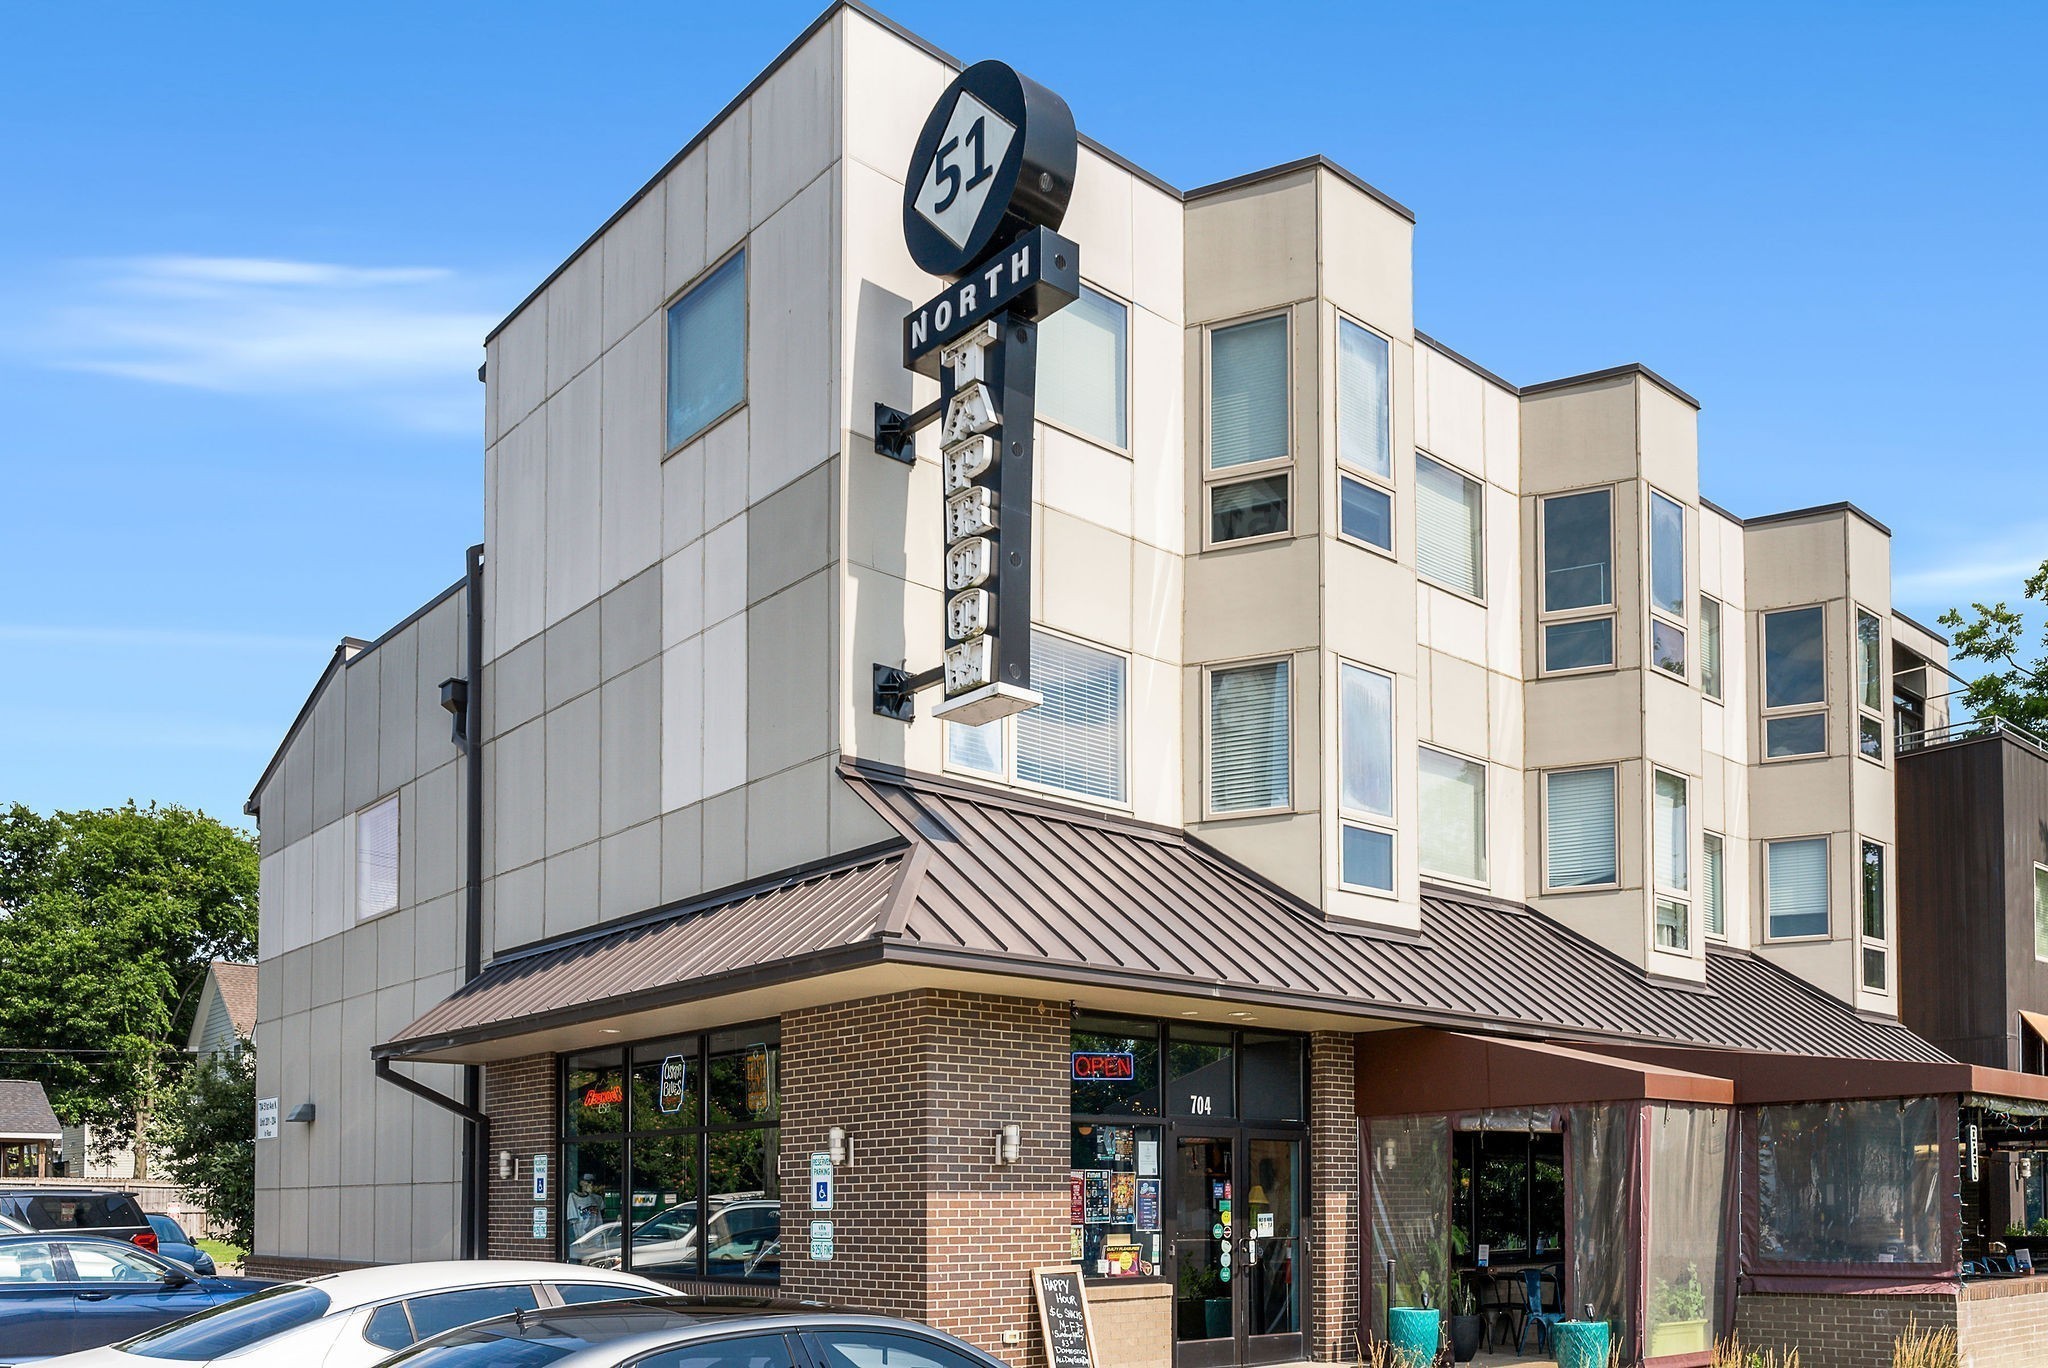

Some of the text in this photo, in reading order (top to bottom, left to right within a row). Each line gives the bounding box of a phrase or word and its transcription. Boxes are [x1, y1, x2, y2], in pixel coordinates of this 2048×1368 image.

[934, 115, 994, 214] 51
[911, 245, 1030, 349] NORTH
[940, 319, 998, 695] TAPROOM
[1075, 1056, 1131, 1077] OPEN
[663, 1080, 682, 1097] BLUES
[1190, 1095, 1212, 1115] 704
[812, 1158, 831, 1166] RESERVE
[814, 1167, 830, 1175] PARKING
[1043, 1277, 1070, 1294] HAPPY
[1056, 1292, 1078, 1306] HOUR
[1049, 1305, 1063, 1319] $6
